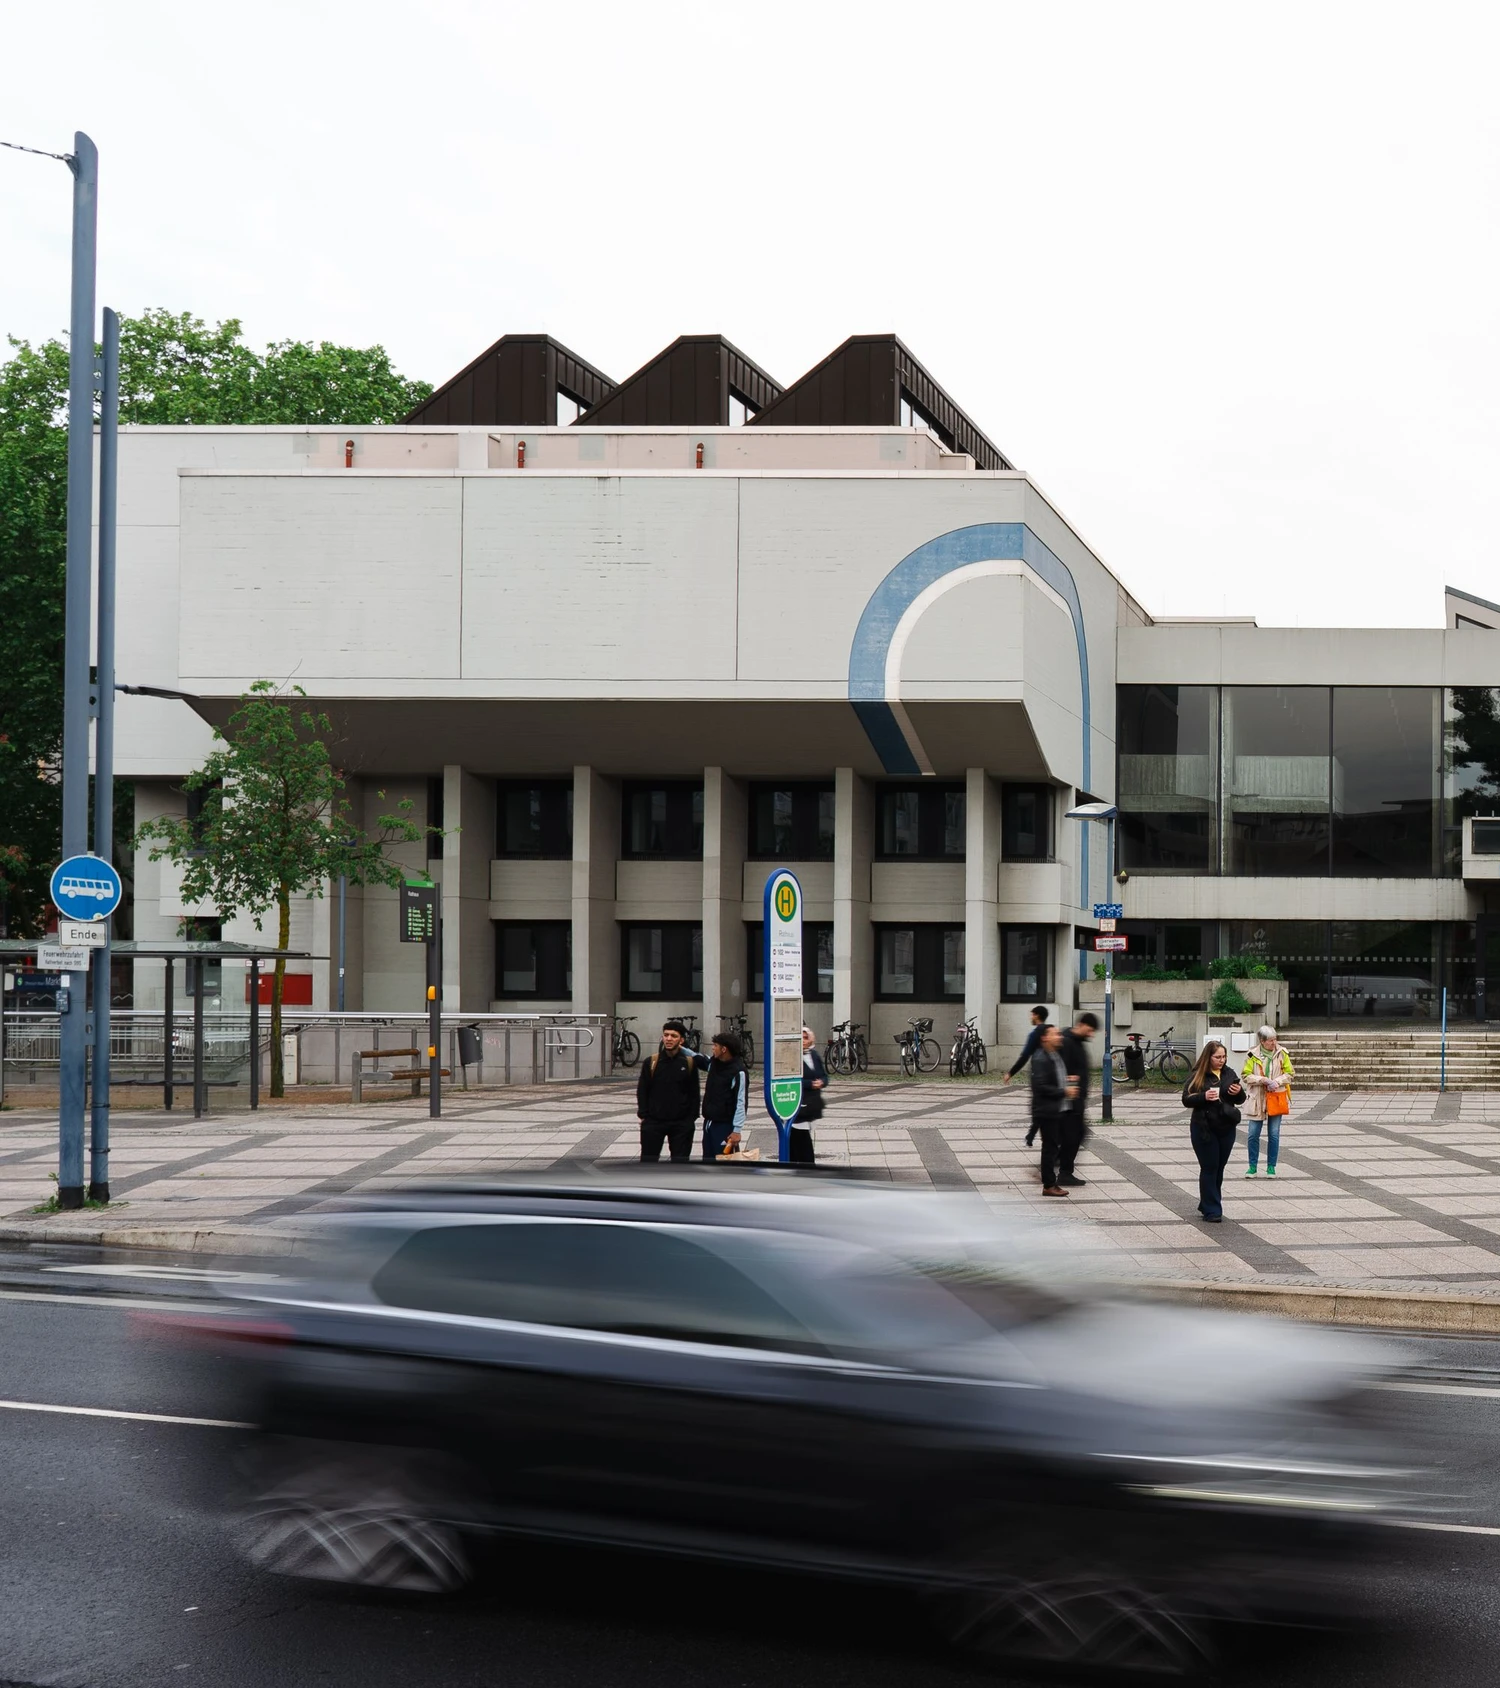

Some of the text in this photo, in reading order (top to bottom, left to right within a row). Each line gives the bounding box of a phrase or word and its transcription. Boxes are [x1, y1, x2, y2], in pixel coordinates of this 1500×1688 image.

[781, 889, 791, 913] H
[70, 929, 97, 940] Ende
[43, 950, 84, 959] Feuerwehrzufahrt
